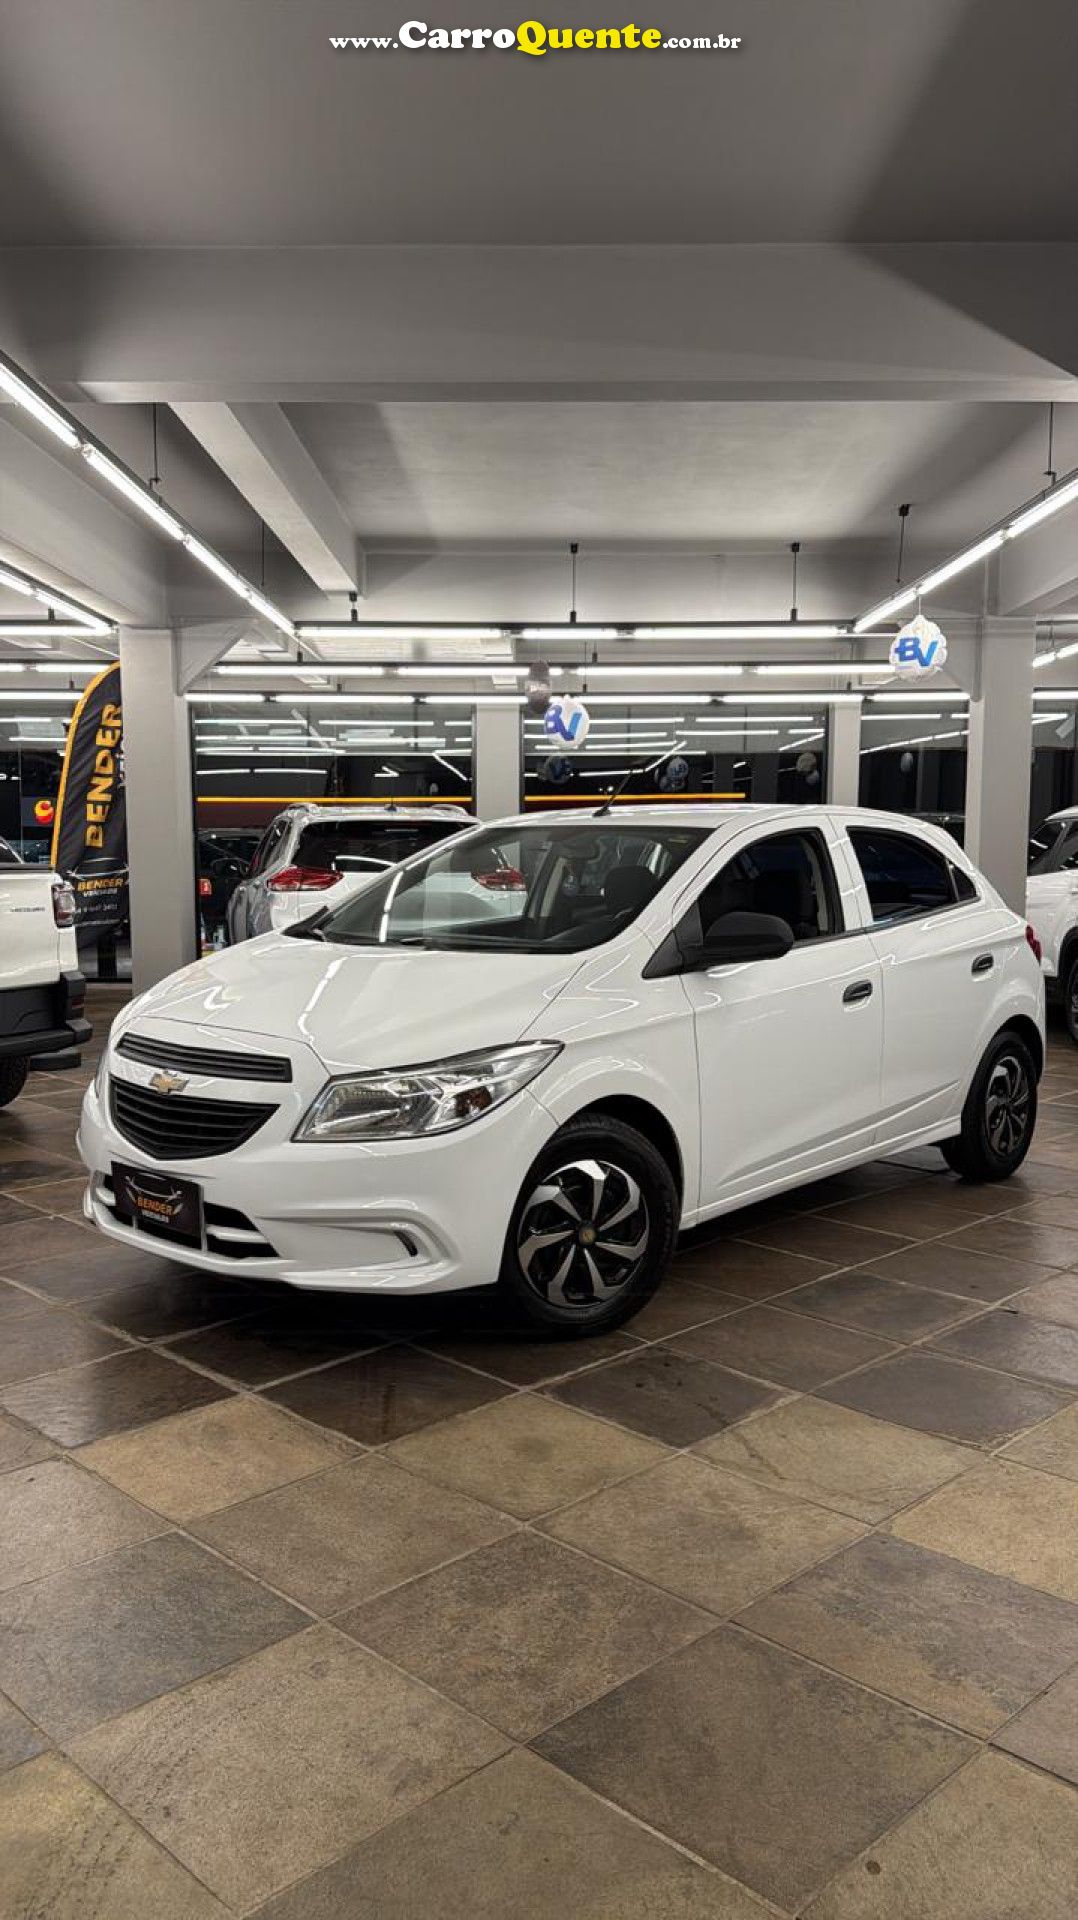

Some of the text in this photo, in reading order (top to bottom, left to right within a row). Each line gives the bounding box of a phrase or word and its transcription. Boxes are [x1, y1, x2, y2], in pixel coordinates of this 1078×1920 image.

[895, 637, 938, 667] BV
[85, 703, 122, 848] BENDER
[138, 1196, 173, 1215] BENDER
